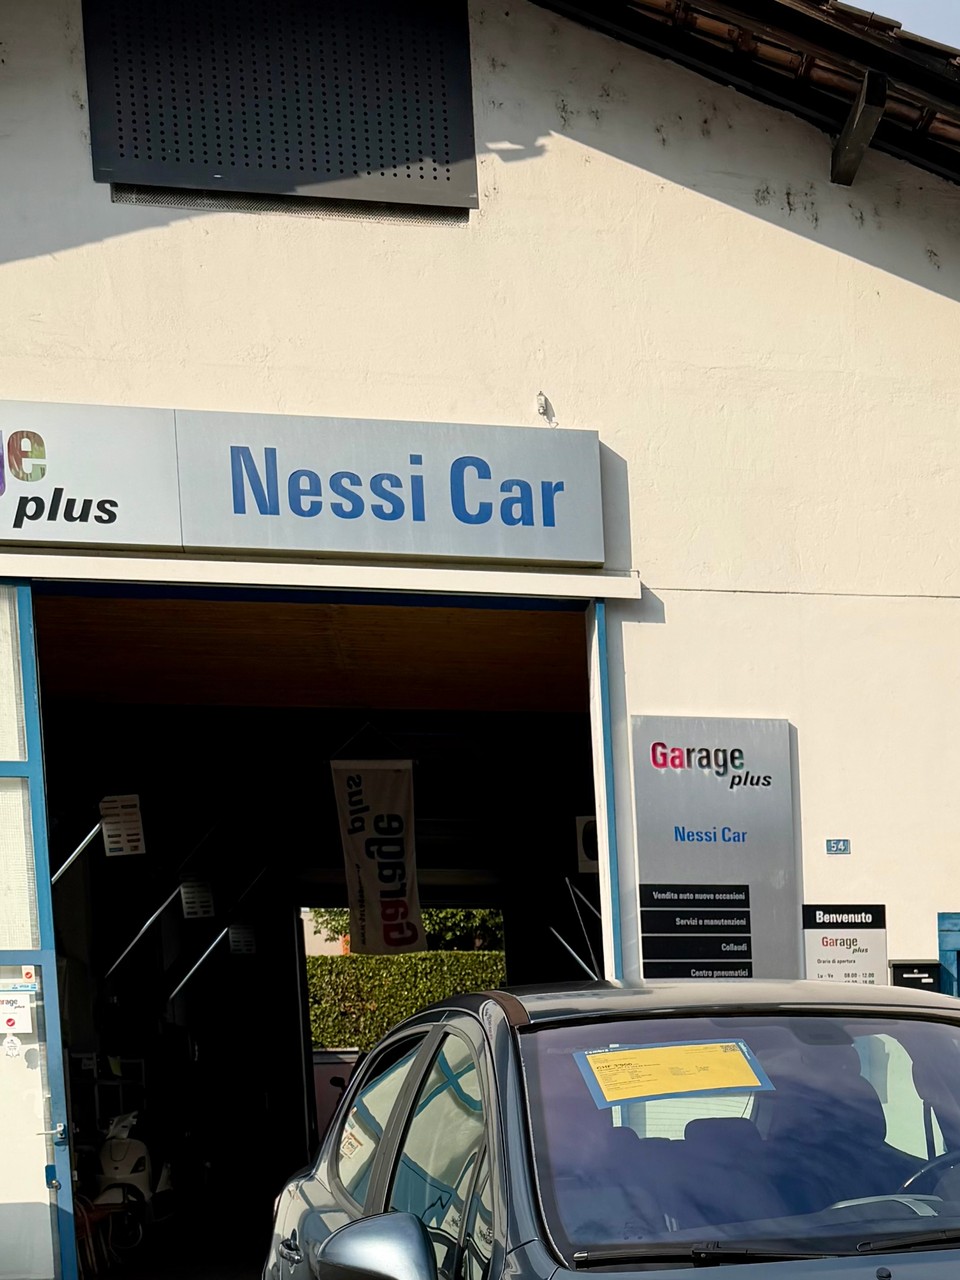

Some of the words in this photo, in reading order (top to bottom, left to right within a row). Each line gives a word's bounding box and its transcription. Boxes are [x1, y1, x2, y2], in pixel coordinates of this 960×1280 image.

[0, 430, 47, 497] e
[229, 445, 427, 522] Nessi
[449, 455, 565, 528] Car
[12, 487, 119, 529] plus
[650, 741, 745, 777] Garage
[729, 770, 773, 790] plus
[674, 825, 717, 842] Nessi
[721, 826, 748, 842] Car
[831, 840, 845, 851] 54
[652, 891, 678, 900] Vendita
[715, 891, 746, 900] occasioni
[675, 917, 698, 926] Servizi
[703, 917, 747, 926] manutenzioni
[815, 910, 873, 923] Benvenuto
[721, 943, 748, 952] Collaudi
[821, 936, 858, 949] Garage
[852, 946, 869, 954] plus
[690, 968, 713, 978] Centro
[713, 968, 749, 979] pneumatici
